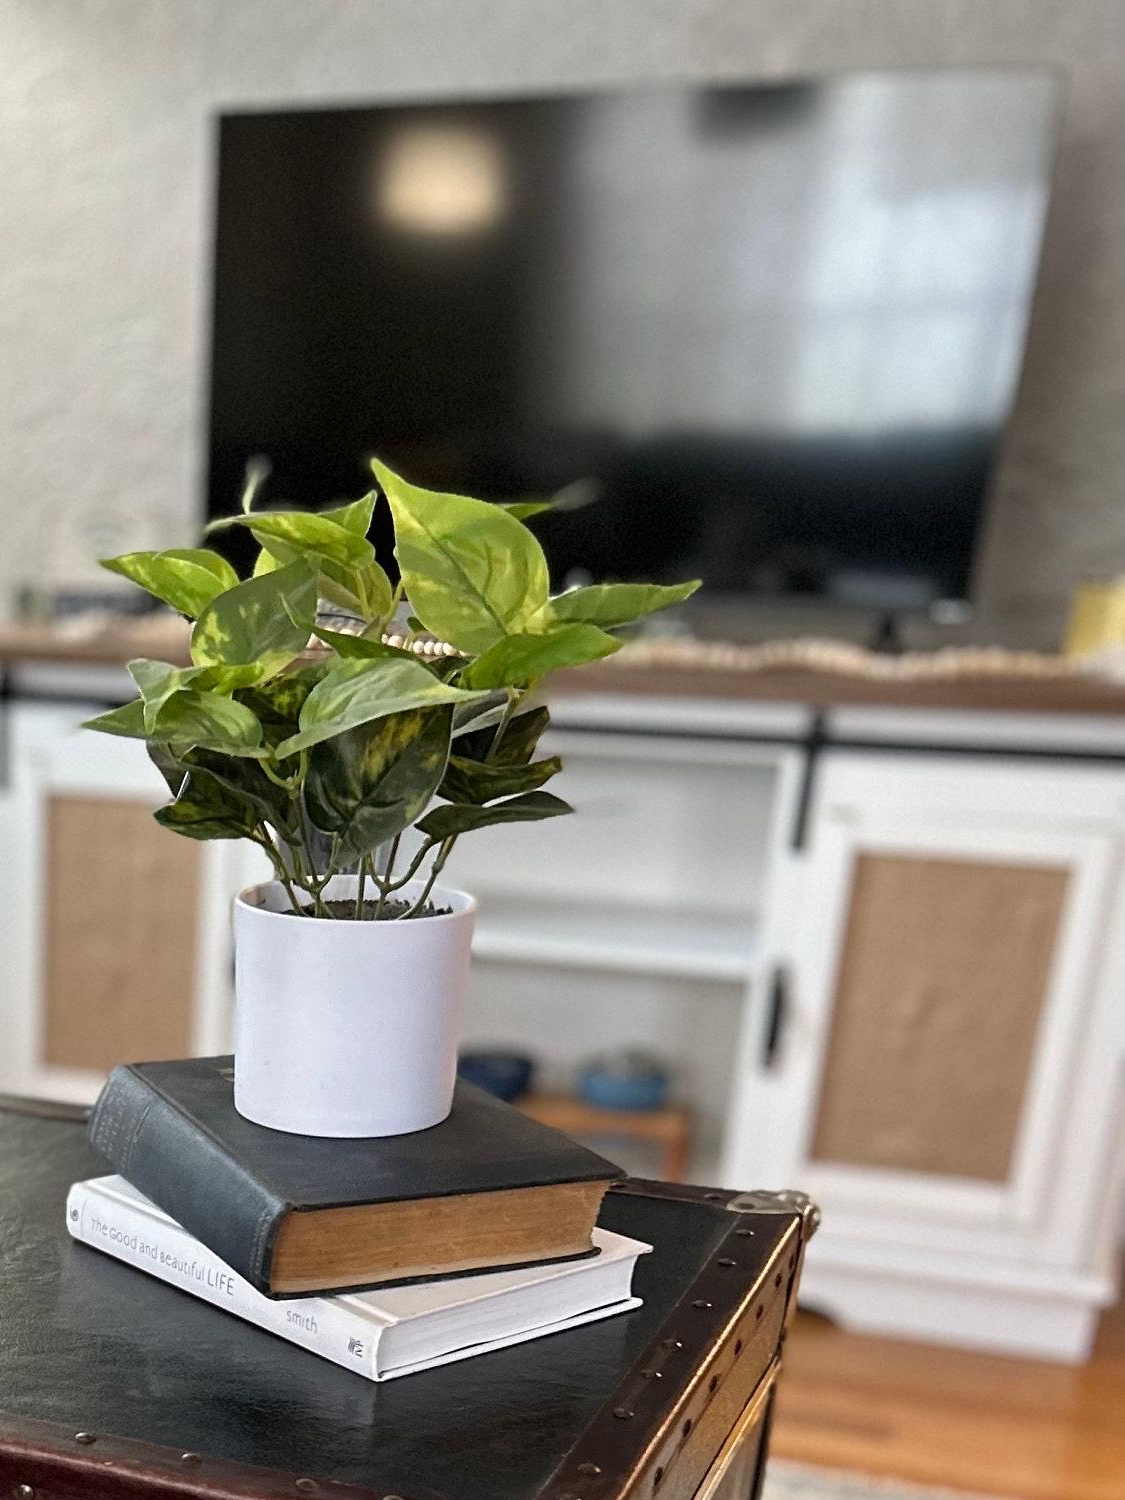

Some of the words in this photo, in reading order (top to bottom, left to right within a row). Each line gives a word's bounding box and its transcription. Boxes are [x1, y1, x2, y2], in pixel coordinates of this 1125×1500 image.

[91, 1217, 108, 1236] The
[109, 1227, 137, 1250] Good
[139, 1242, 158, 1260] and
[159, 1251, 206, 1281] Beautiful
[207, 1268, 236, 1296] LIFE
